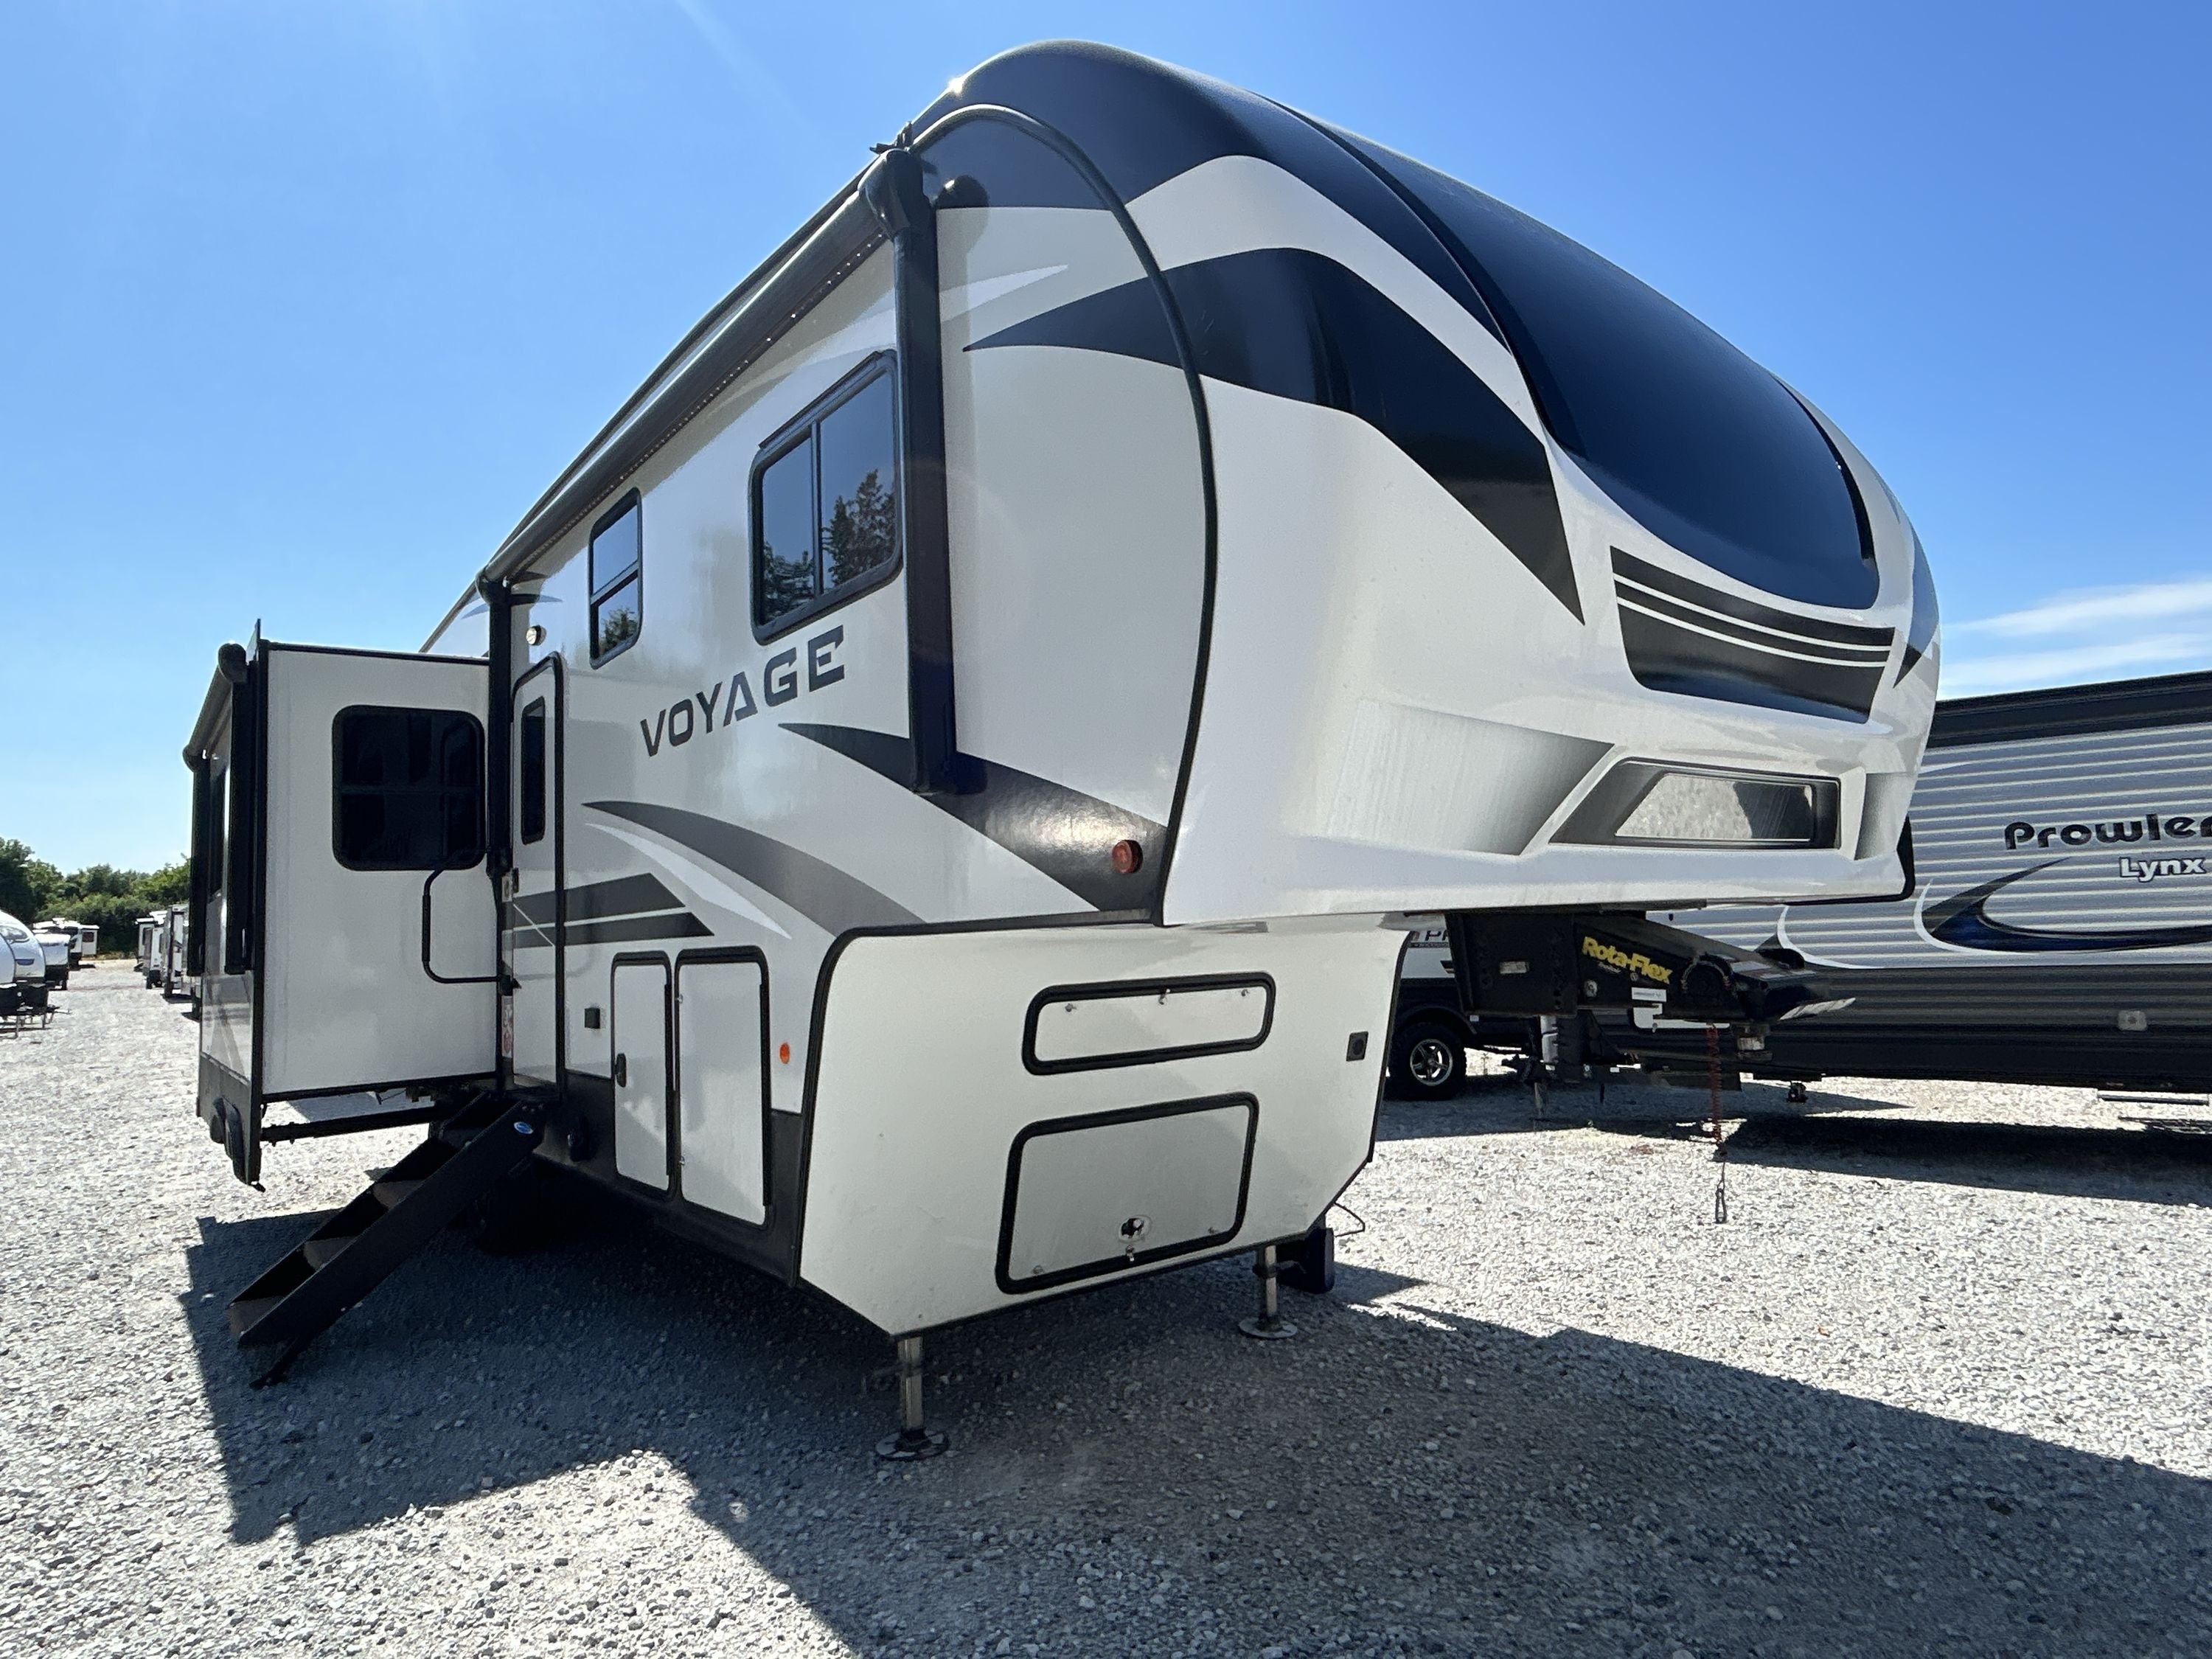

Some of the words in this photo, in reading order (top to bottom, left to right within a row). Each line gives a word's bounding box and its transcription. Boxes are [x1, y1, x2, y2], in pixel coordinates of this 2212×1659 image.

[640, 625, 845, 757] VOYAGE
[2118, 856, 2206, 882] Lynx
[1582, 936, 1672, 984] Rota-Flex
